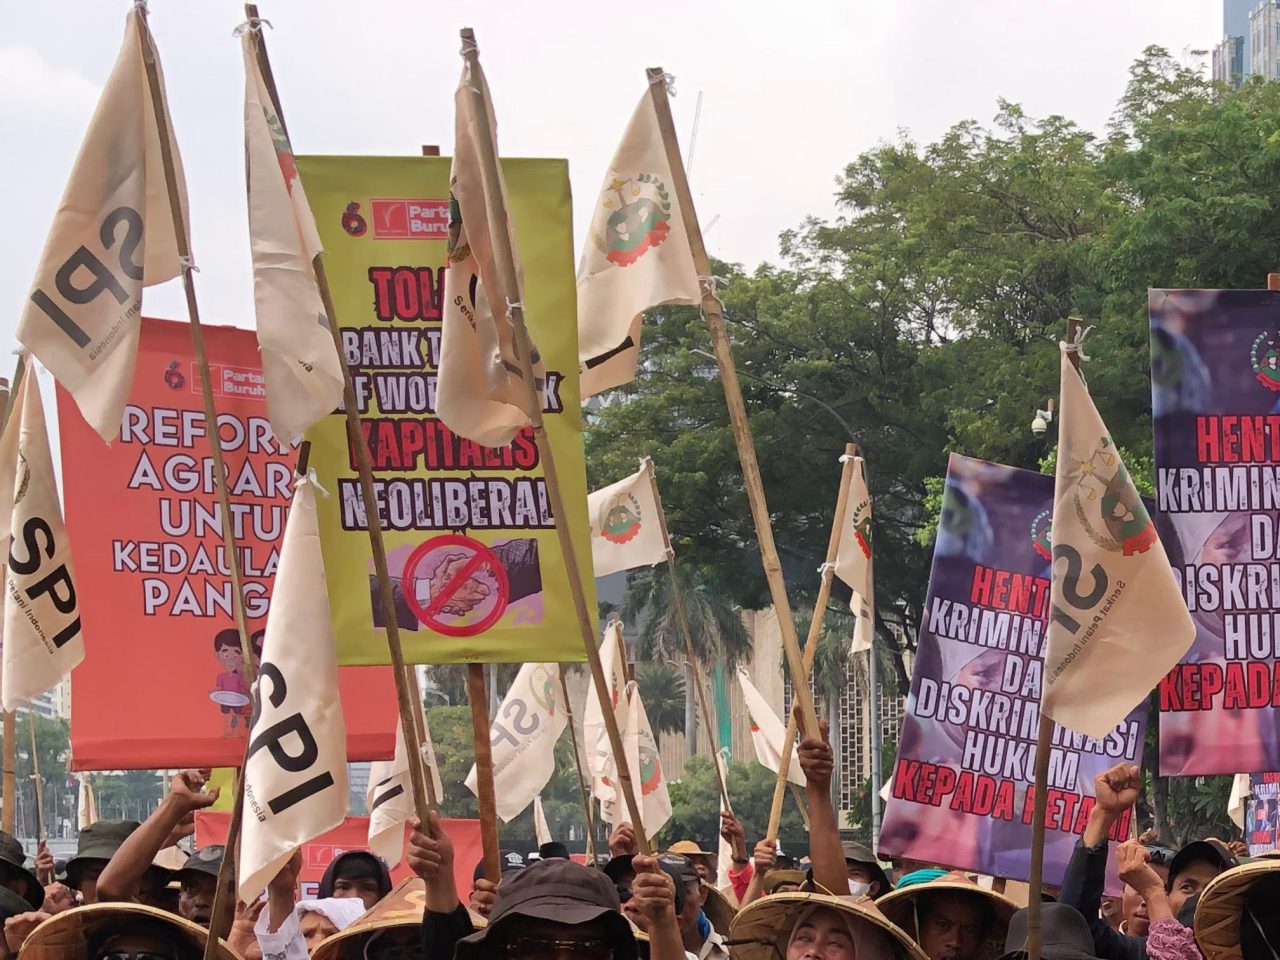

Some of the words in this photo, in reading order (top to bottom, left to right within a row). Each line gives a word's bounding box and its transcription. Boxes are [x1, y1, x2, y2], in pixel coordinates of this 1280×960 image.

[409, 206, 450, 218] Part
[410, 220, 450, 232] Buru
[372, 269, 446, 319] TOL
[342, 330, 421, 365] BANK
[223, 370, 265, 385] Parta
[120, 405, 302, 455] REFOR
[128, 451, 294, 499] AGRAR
[159, 499, 289, 541] UNTU
[9, 517, 82, 649] SPI
[143, 578, 270, 619] PANG
[1001, 653, 1042, 699] DA
[893, 759, 1013, 821] KEPADA
